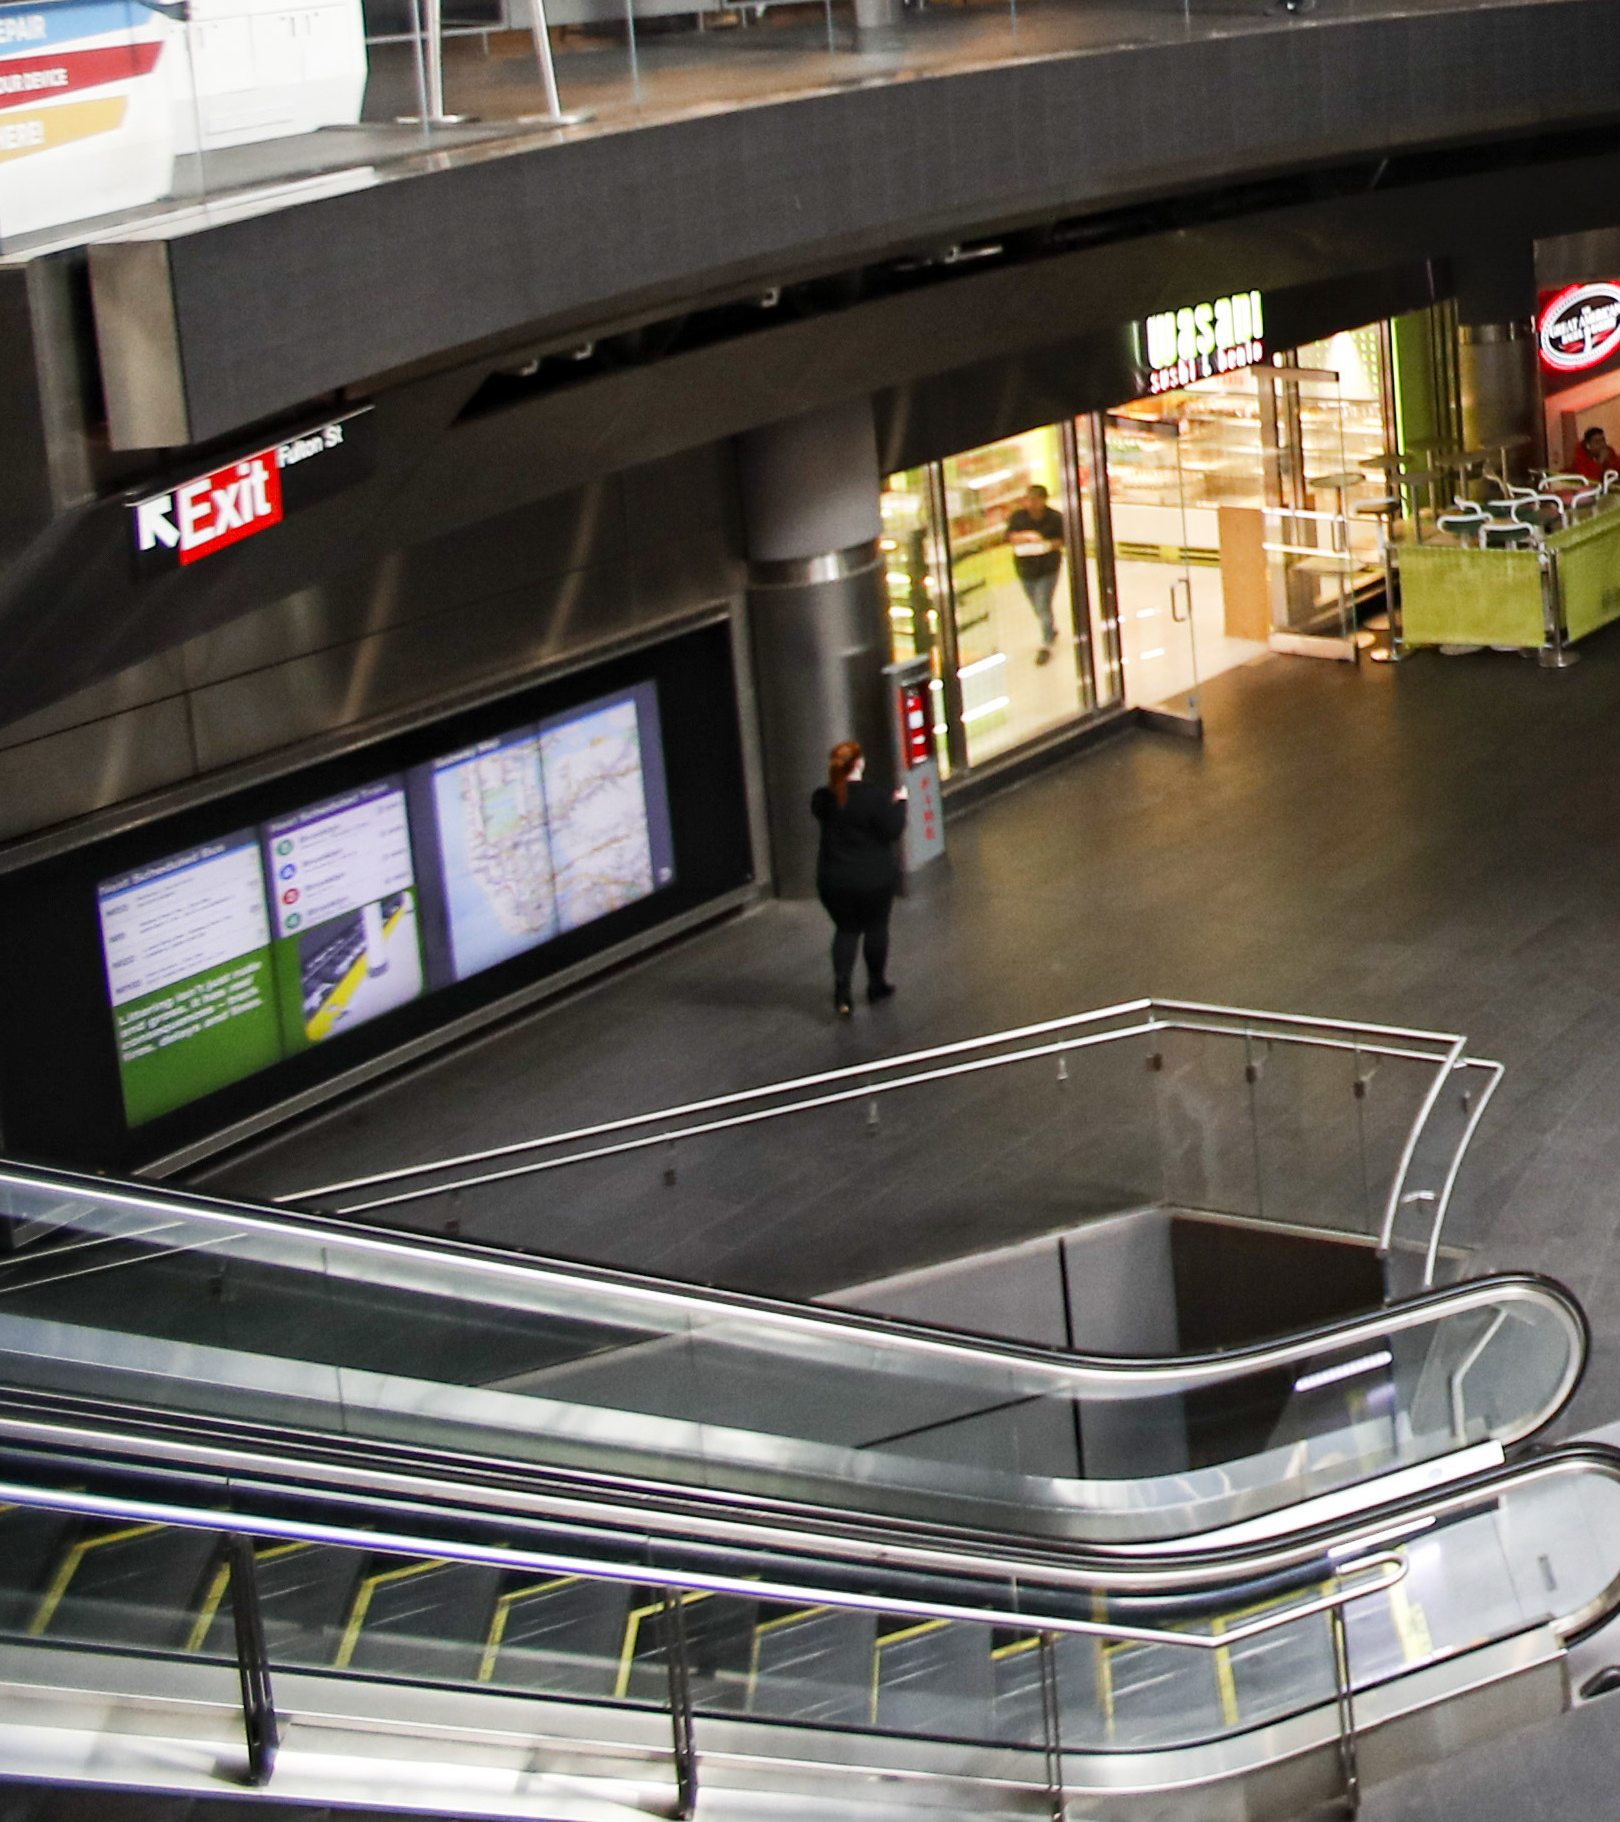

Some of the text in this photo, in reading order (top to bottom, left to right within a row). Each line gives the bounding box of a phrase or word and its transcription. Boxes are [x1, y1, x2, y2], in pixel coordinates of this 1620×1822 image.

[1150, 358, 1197, 394] sushi
[1216, 340, 1264, 373] bento
[277, 424, 345, 469] Fulton St
[176, 459, 272, 551] Exit
